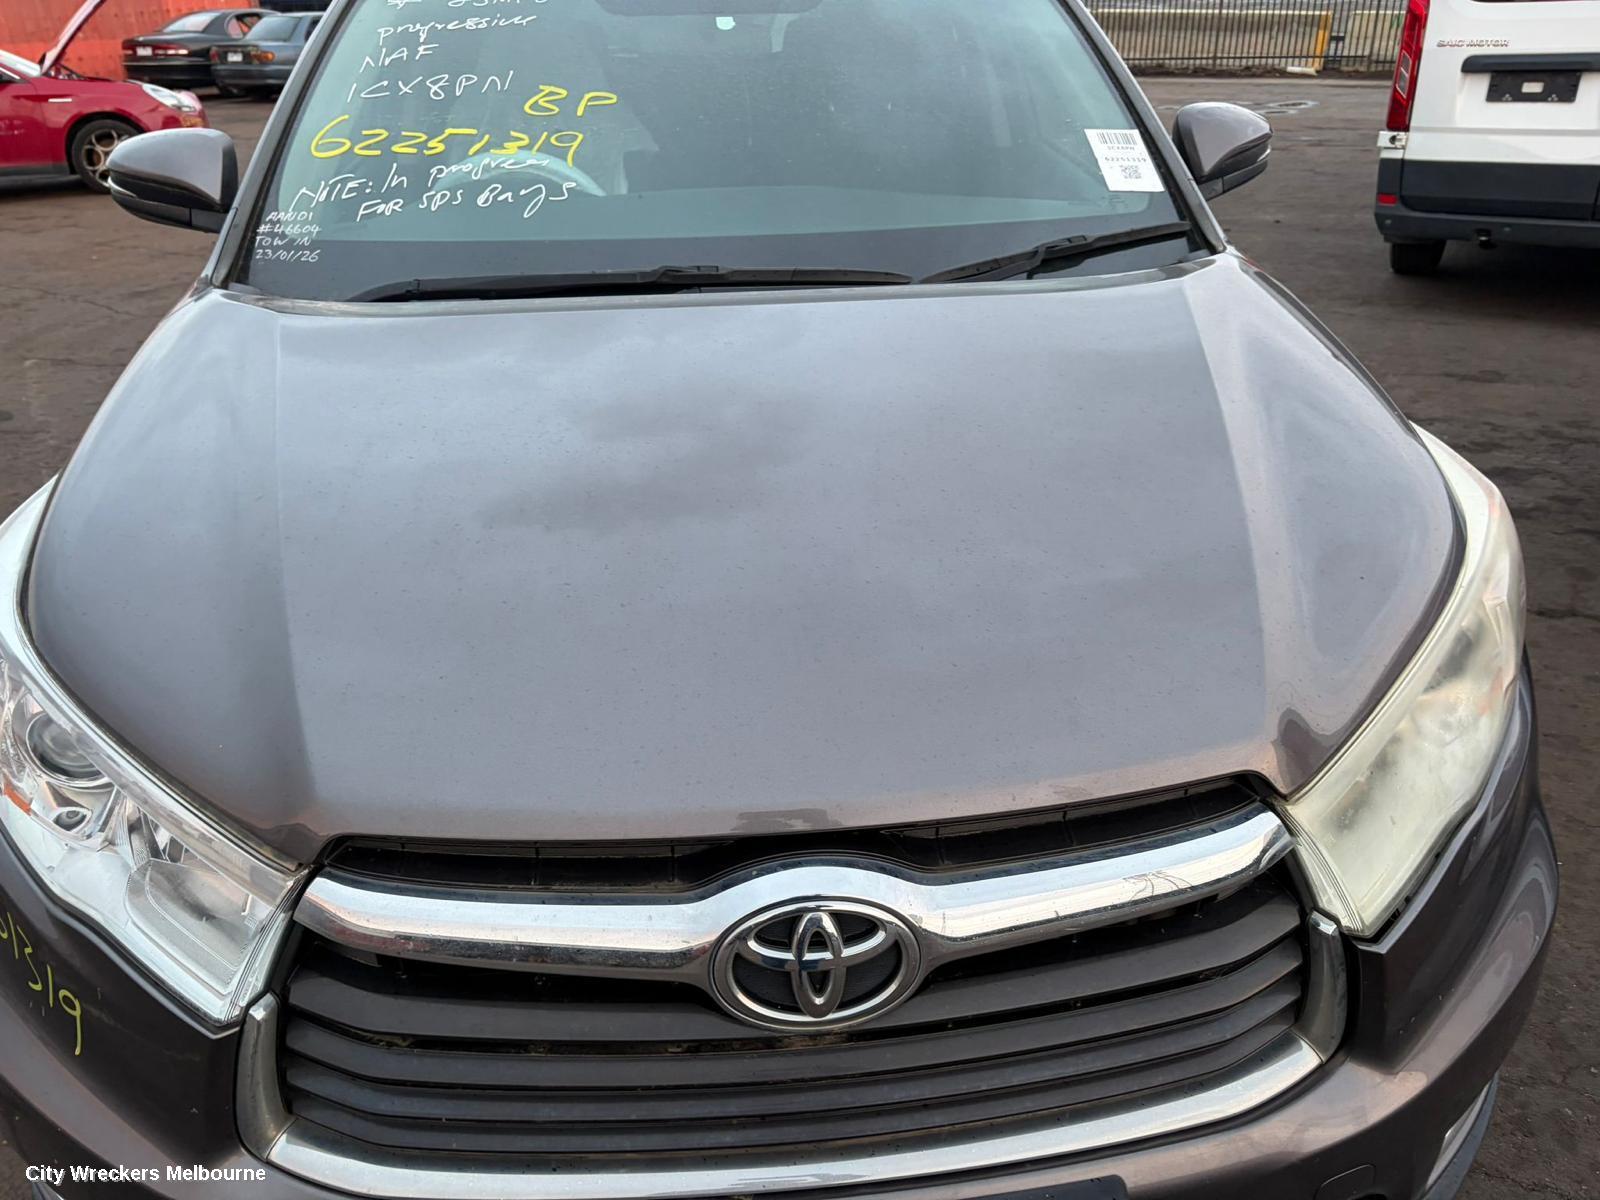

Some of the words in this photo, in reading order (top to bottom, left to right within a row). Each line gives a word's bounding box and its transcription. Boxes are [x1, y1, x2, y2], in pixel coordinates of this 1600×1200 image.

[1436, 39, 1464, 48] SAIC
[1466, 39, 1510, 48] MOTOR
[310, 114, 584, 168] 62251319
[356, 198, 403, 222] FOR
[255, 249, 321, 263] 23/01/26
